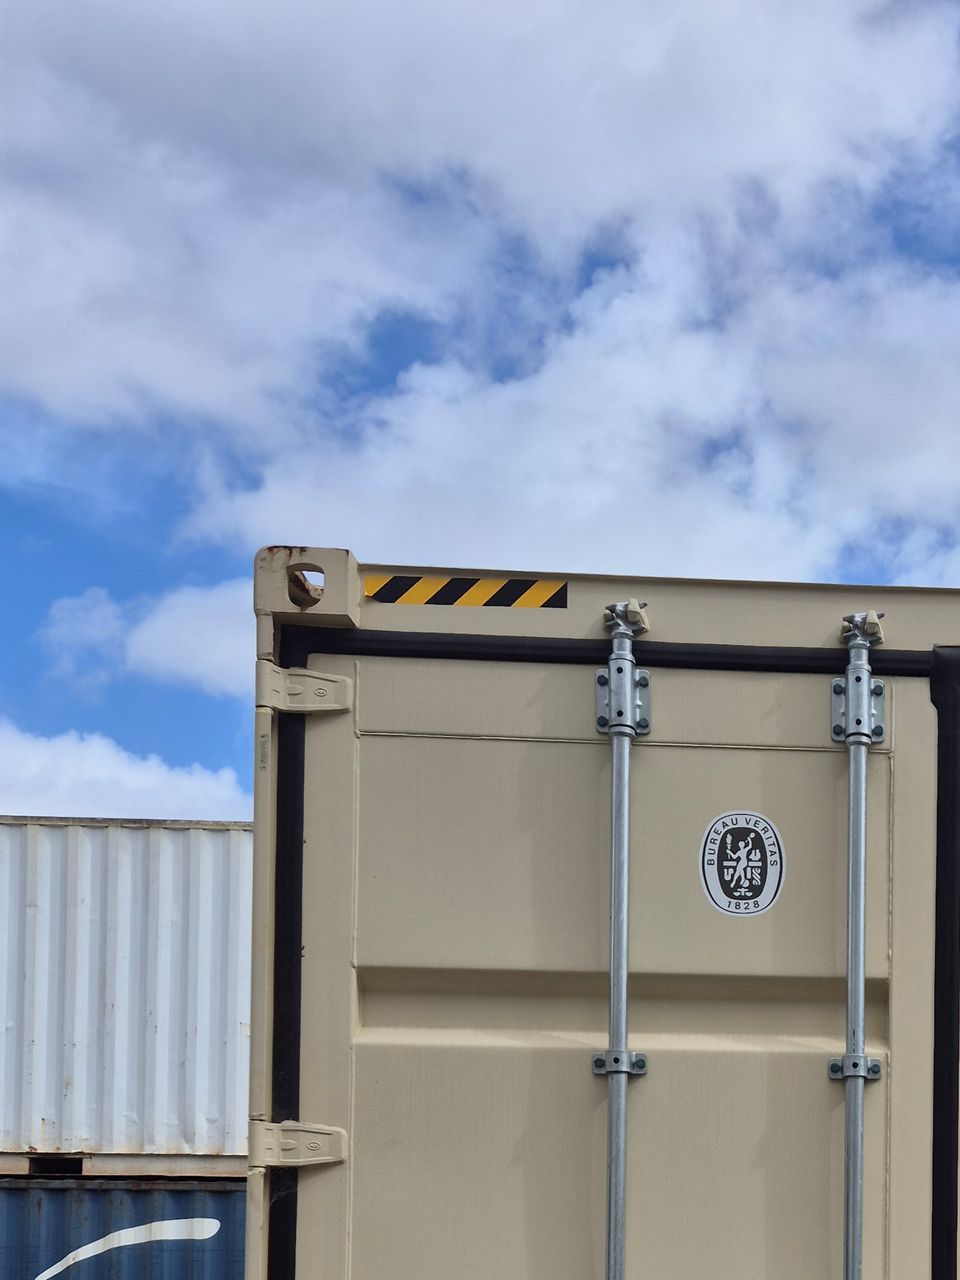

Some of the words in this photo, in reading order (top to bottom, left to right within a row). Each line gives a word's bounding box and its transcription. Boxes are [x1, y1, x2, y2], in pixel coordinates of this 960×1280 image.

[706, 817, 739, 866] BUREAU
[744, 817, 778, 867] VERITAS
[726, 900, 760, 911] 1828
